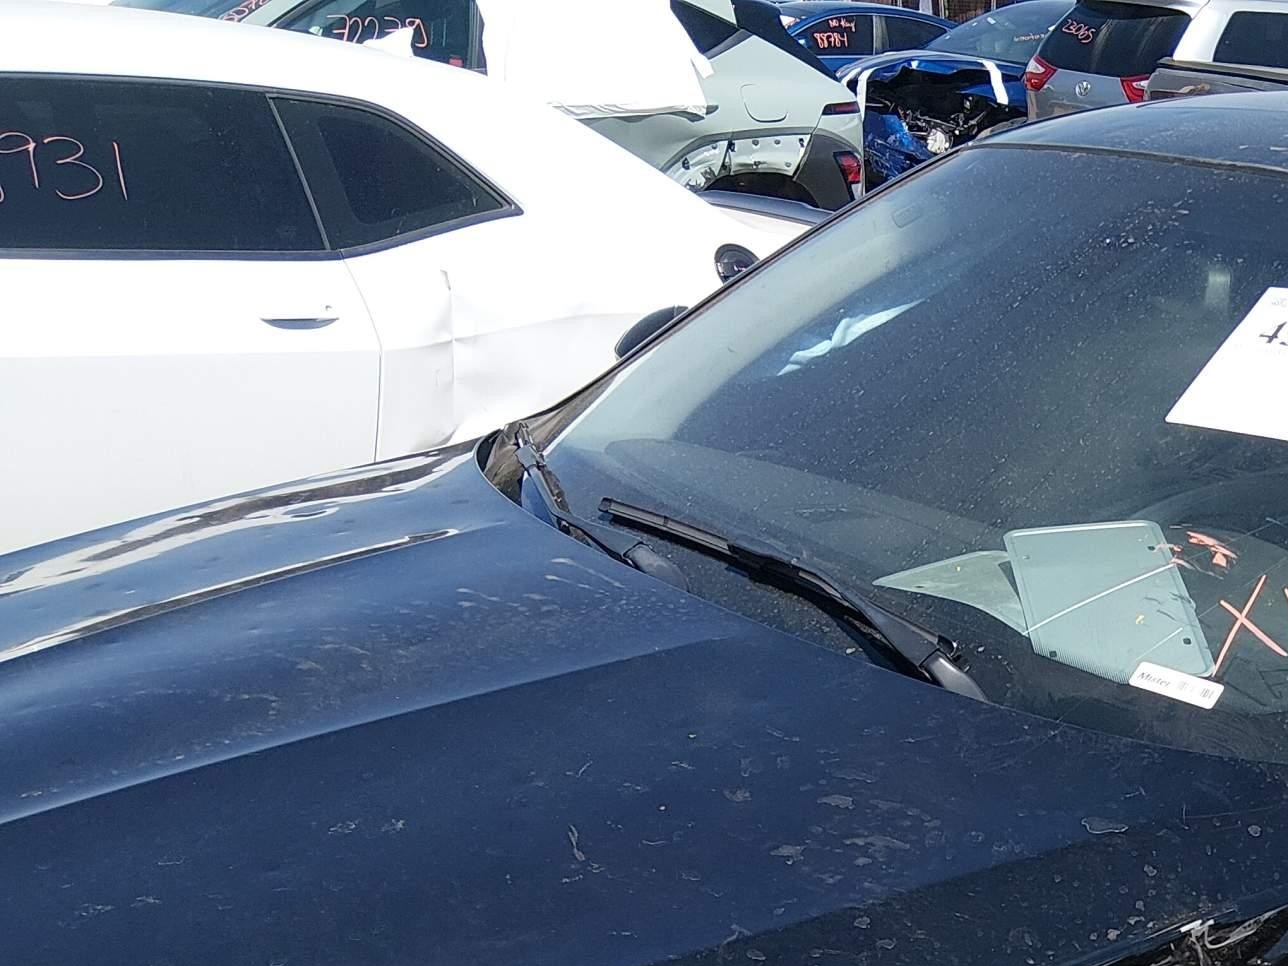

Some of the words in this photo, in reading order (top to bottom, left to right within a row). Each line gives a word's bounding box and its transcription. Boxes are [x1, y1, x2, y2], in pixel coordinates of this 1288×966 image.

[813, 32, 848, 49] 88784
[1062, 19, 1097, 43] 23065
[0, 132, 128, 200] 931
